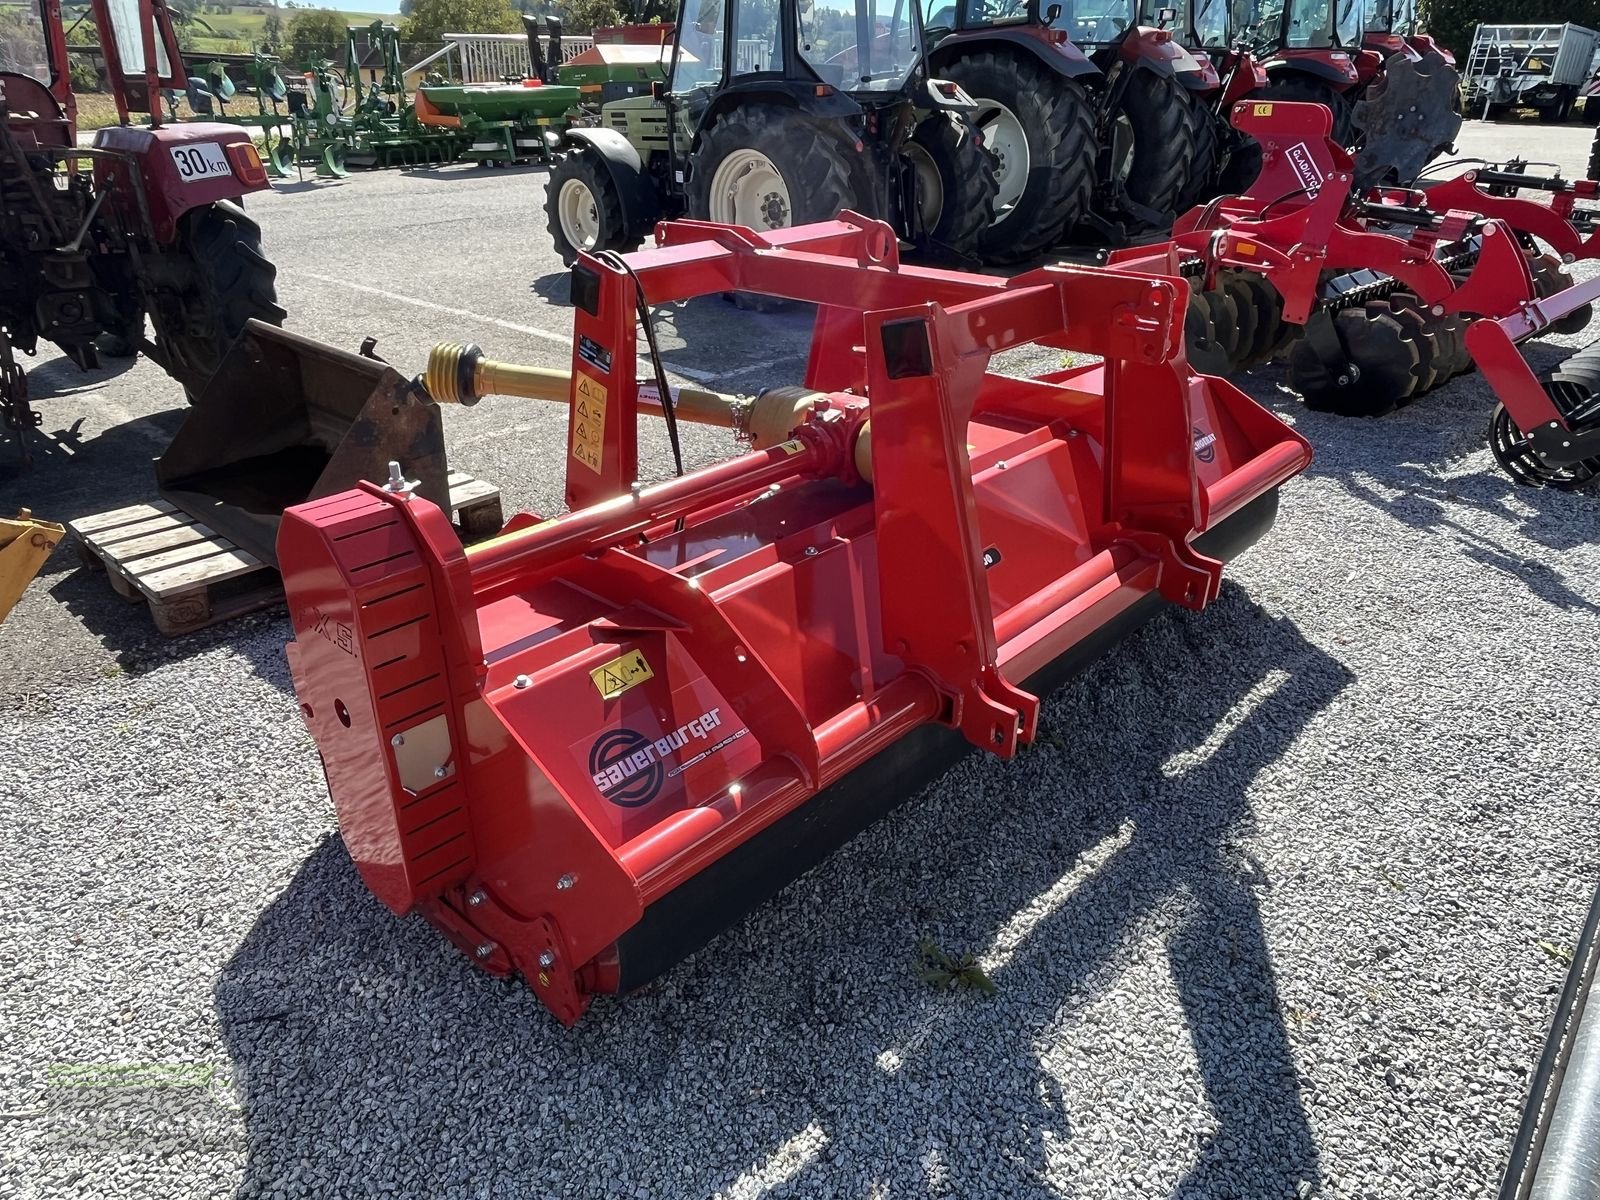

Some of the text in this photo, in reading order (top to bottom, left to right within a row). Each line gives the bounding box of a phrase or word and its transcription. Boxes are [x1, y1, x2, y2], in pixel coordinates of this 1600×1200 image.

[174, 148, 229, 177] 30 km
[1293, 149, 1319, 193] GLADIATO
